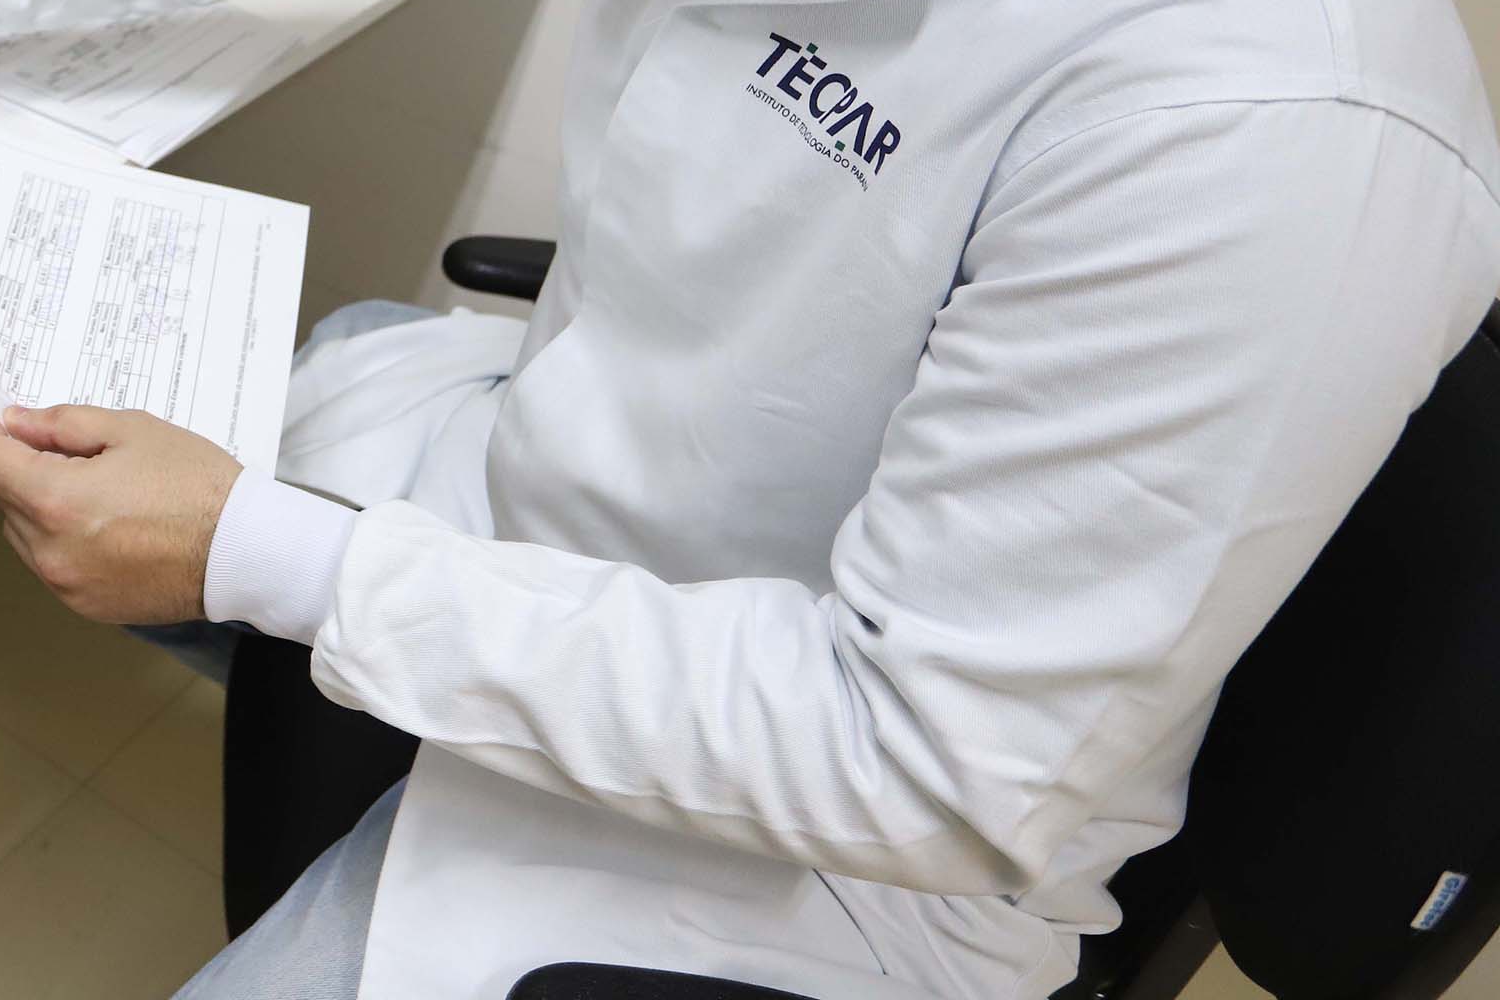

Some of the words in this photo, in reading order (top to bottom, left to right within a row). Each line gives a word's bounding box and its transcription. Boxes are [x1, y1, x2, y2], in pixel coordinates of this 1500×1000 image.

[746, 83, 790, 118] INSTITUTO
[789, 113, 799, 126] DE
[833, 153, 850, 169] DO
[756, 32, 901, 176] TECPAR
